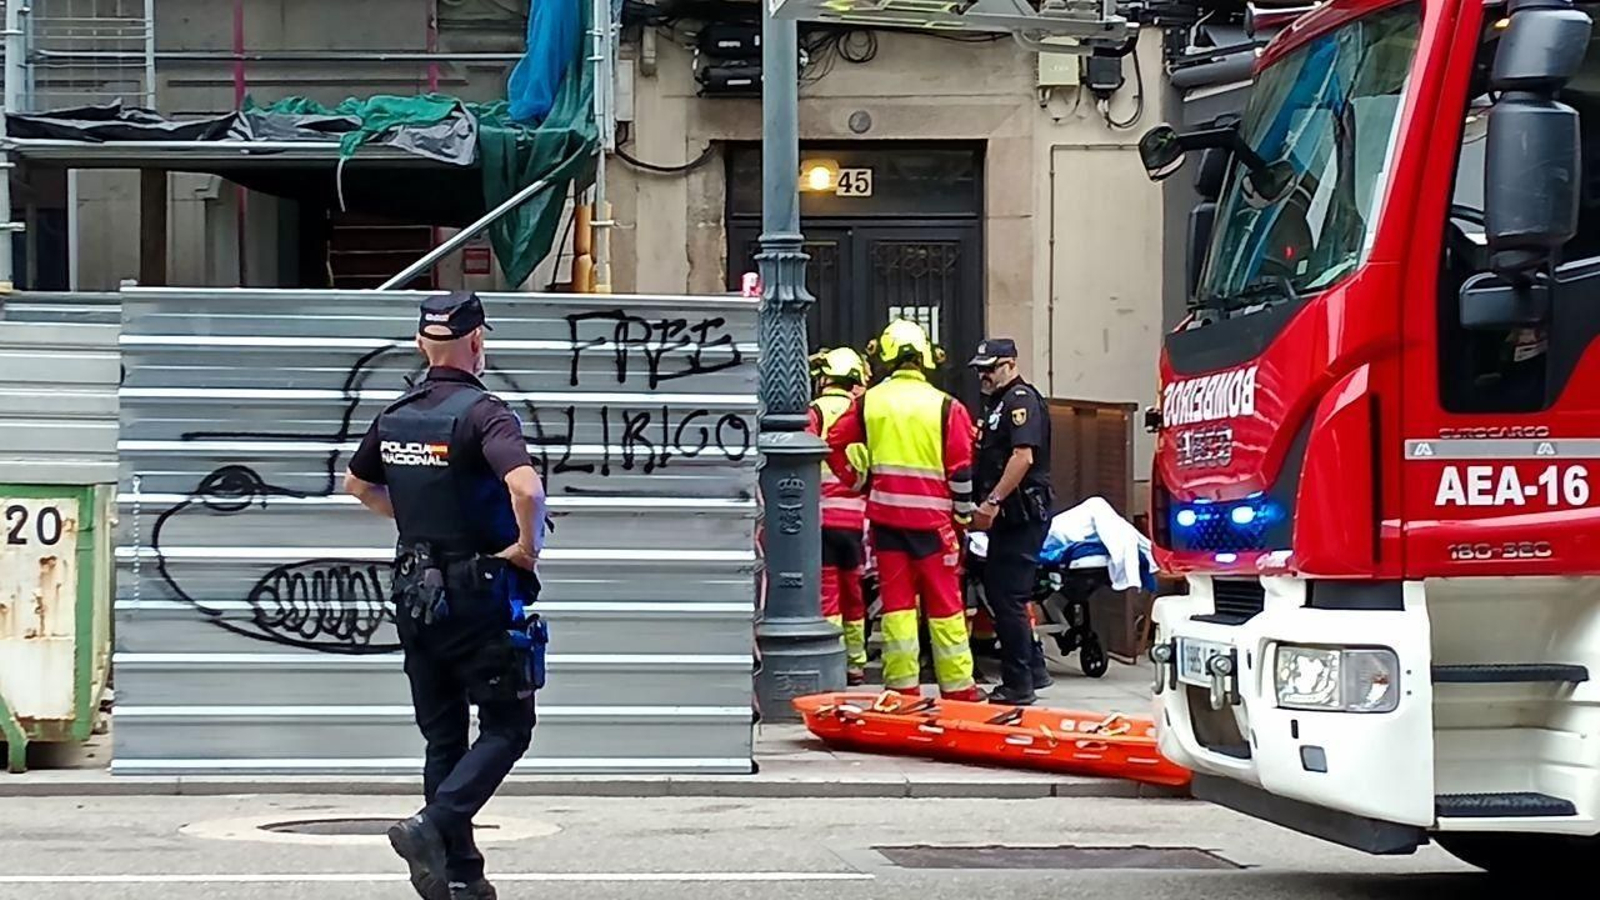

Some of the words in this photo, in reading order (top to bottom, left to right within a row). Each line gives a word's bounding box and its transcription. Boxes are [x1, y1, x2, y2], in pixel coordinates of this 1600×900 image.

[838, 171, 869, 193] 45
[565, 309, 742, 390] FREE
[380, 441, 433, 454] POLICIA
[1434, 464, 1590, 506] AEA-16
[6, 505, 62, 546] 20
